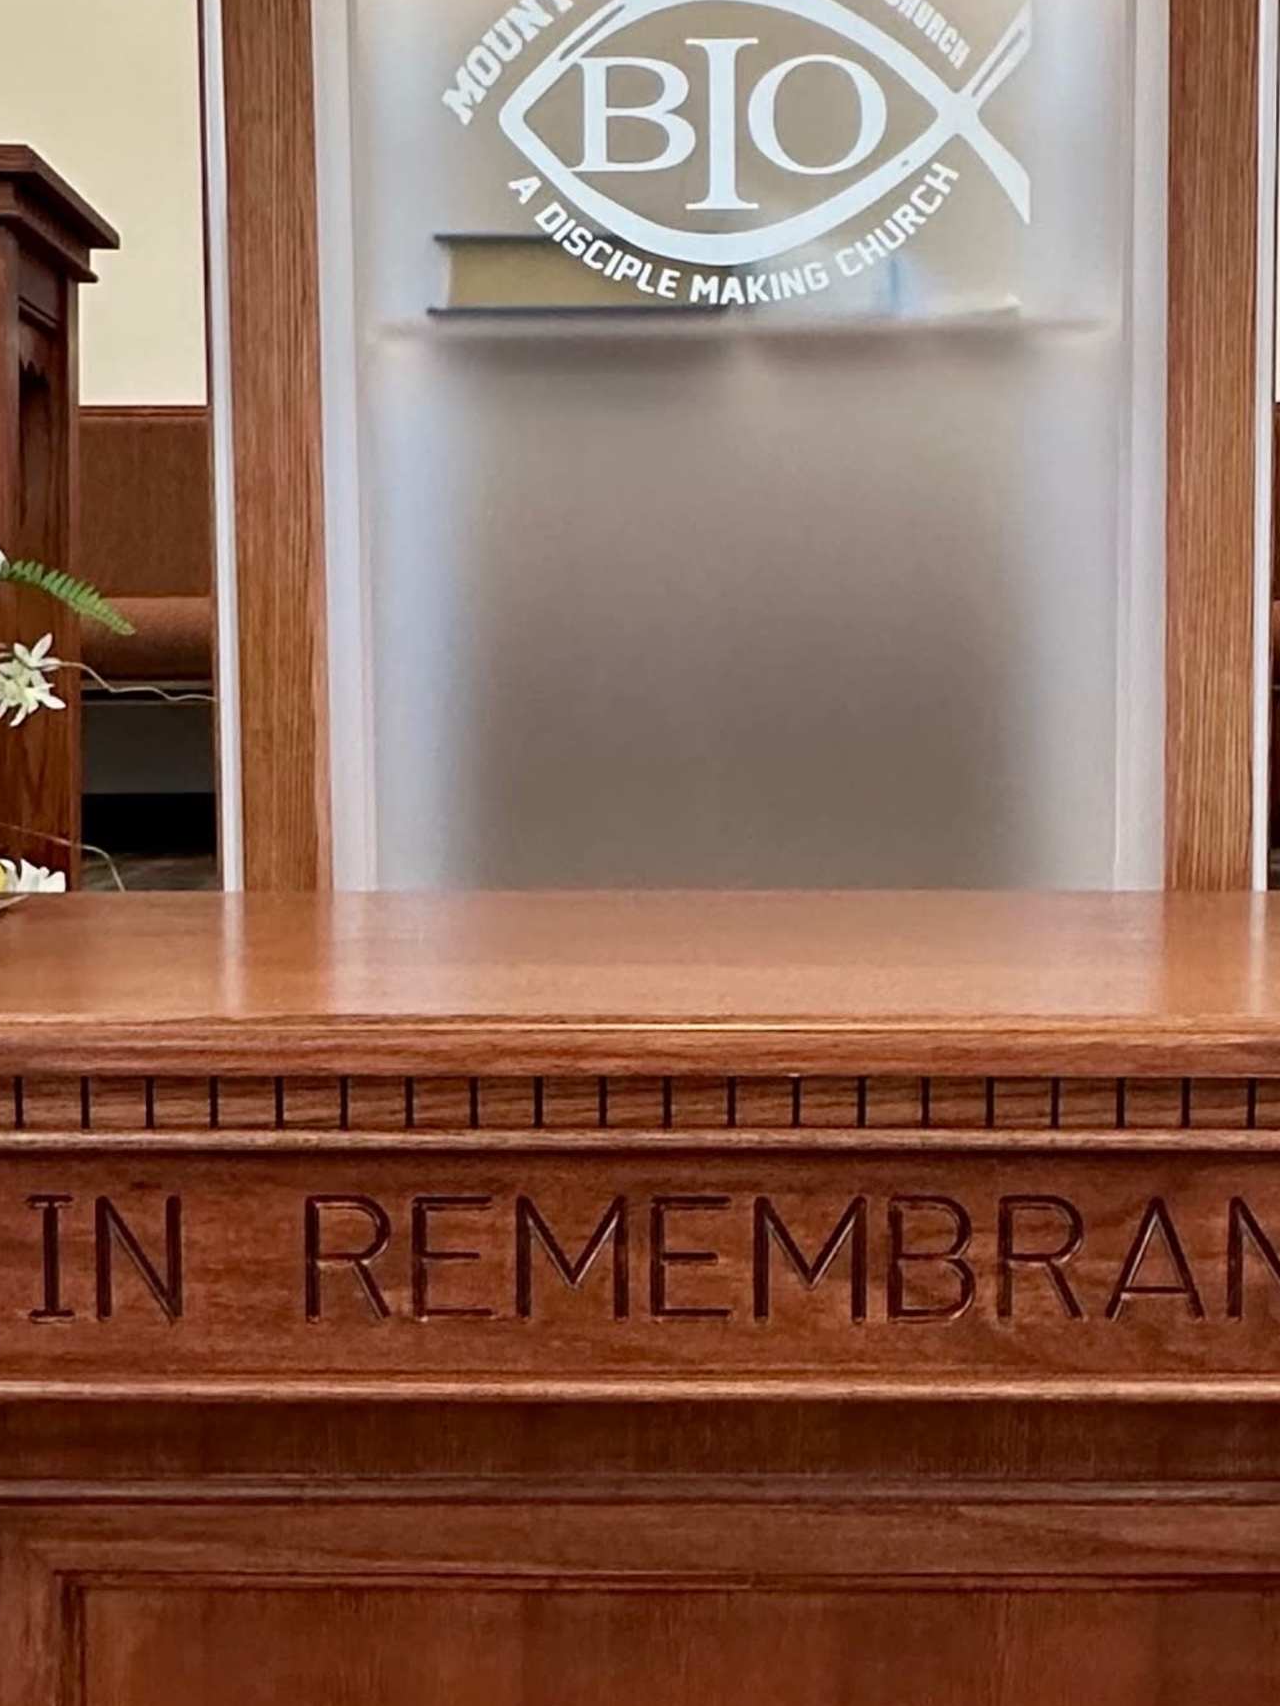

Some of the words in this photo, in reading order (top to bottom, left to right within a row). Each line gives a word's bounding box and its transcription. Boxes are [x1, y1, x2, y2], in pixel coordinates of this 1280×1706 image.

[570, 37, 888, 211] BIO
[507, 173, 542, 205] A
[534, 201, 681, 301] DISCIPLE
[689, 262, 830, 307] MAKING
[840, 162, 960, 279] CHURCH
[26, 1193, 183, 1323] IN
